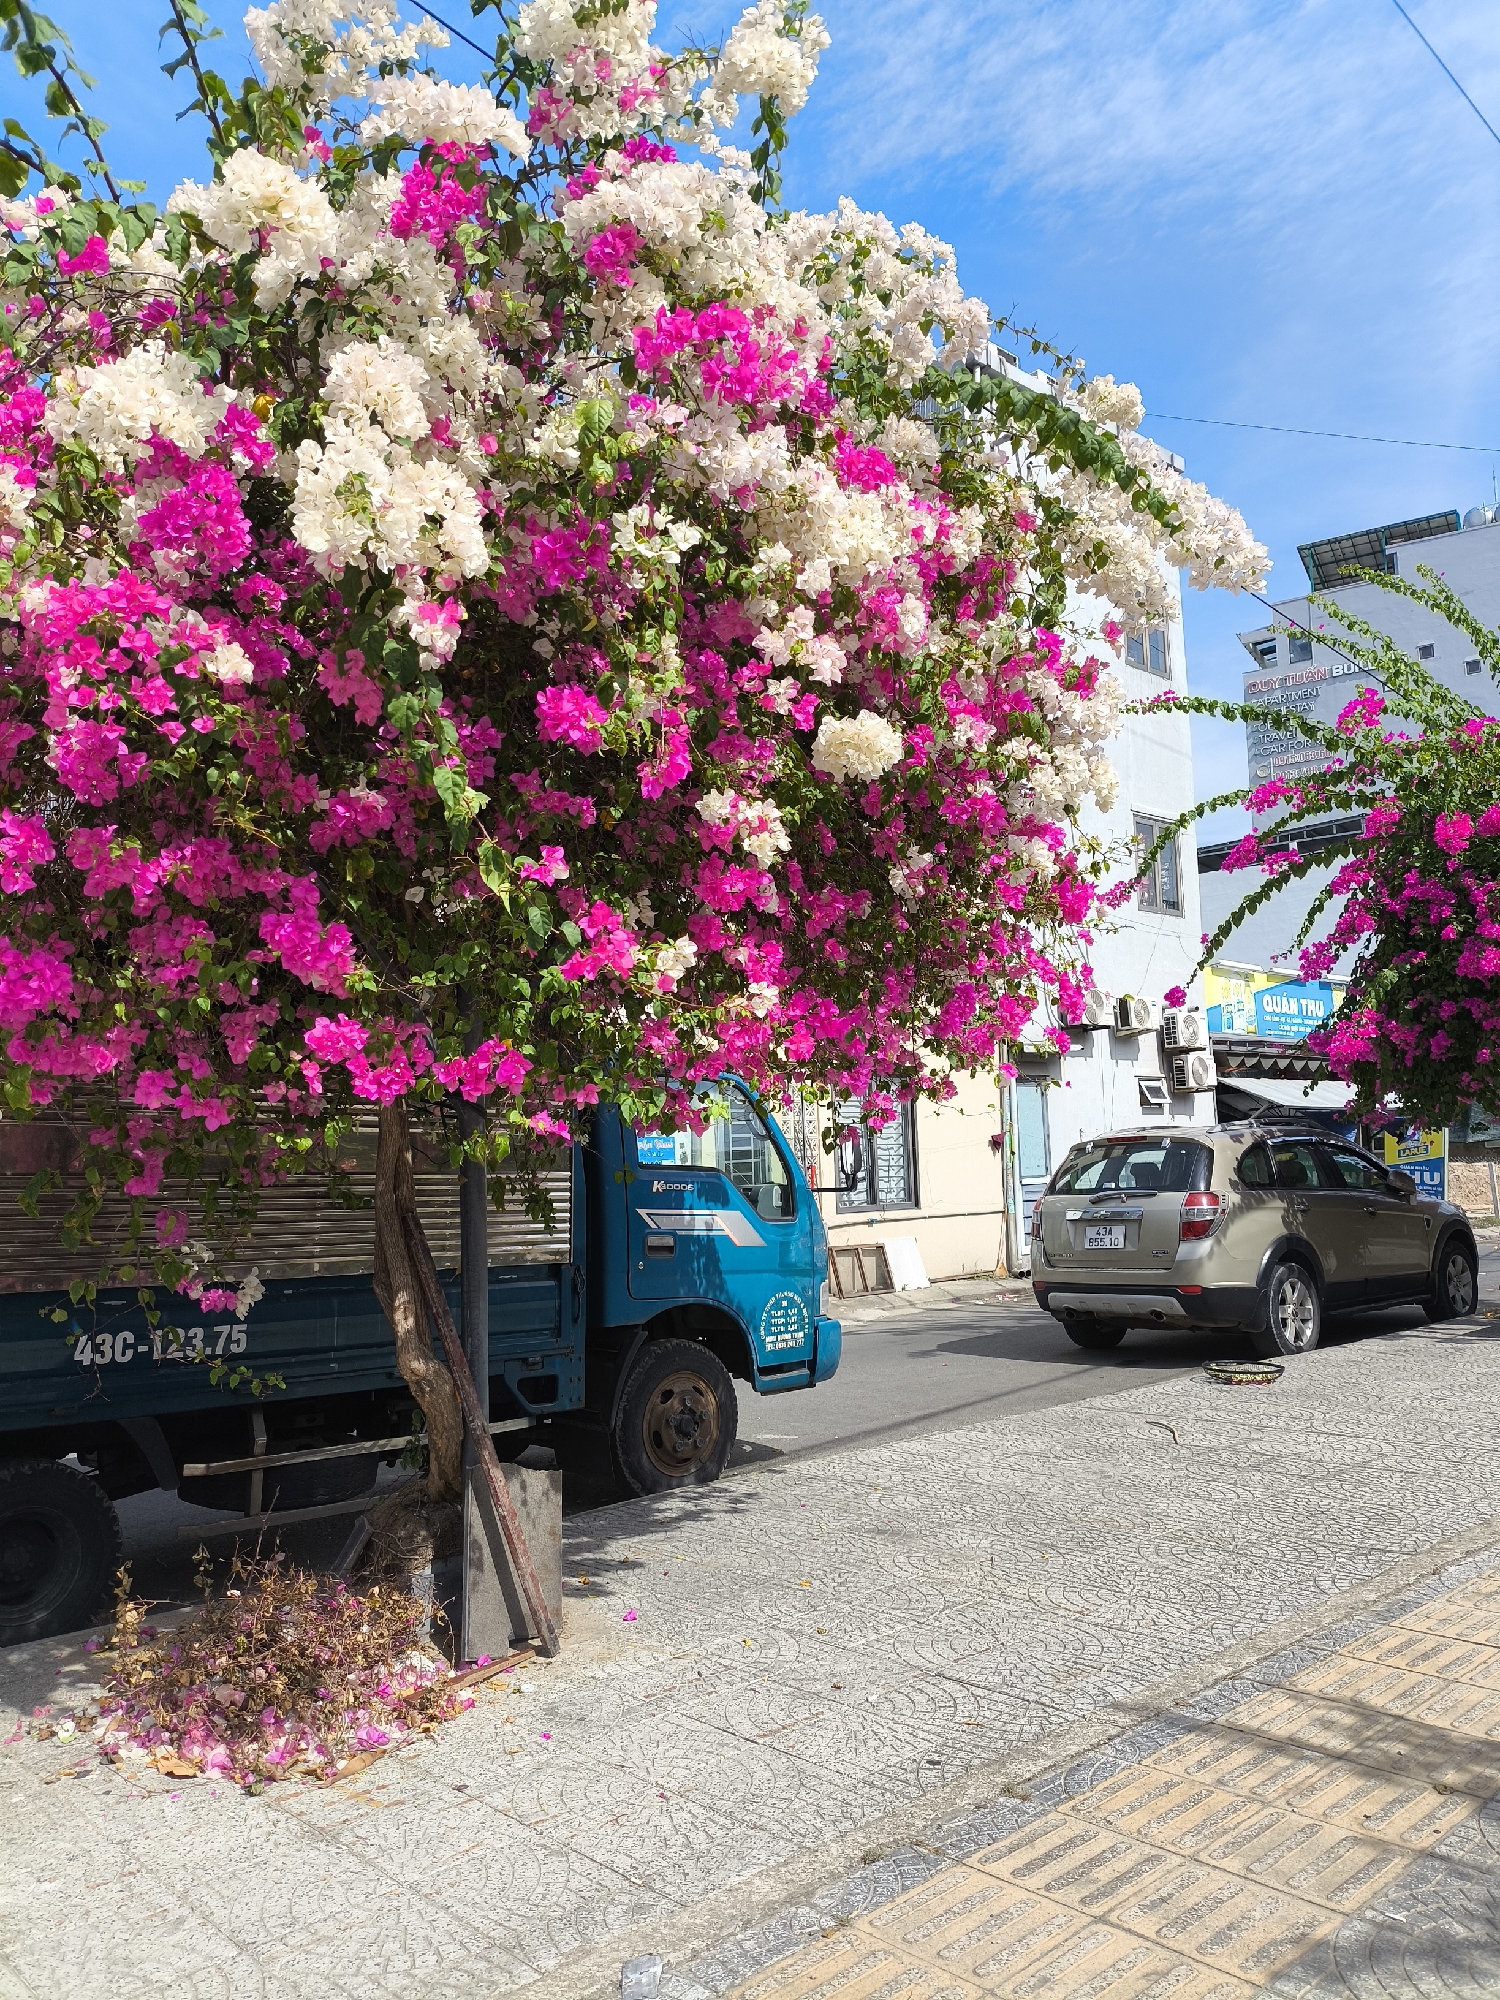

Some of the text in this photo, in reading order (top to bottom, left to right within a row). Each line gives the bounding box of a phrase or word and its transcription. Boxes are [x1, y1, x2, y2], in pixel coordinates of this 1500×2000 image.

[1248, 679, 1279, 694] DUY
[1261, 743, 1286, 756] CAR
[1288, 738, 1312, 750] FOR
[1262, 991, 1324, 1018] QUÁN THU
[1400, 1146, 1426, 1156] LARUE
[1096, 1226, 1112, 1236] 43A
[74, 1324, 248, 1366] 43C-123.75
